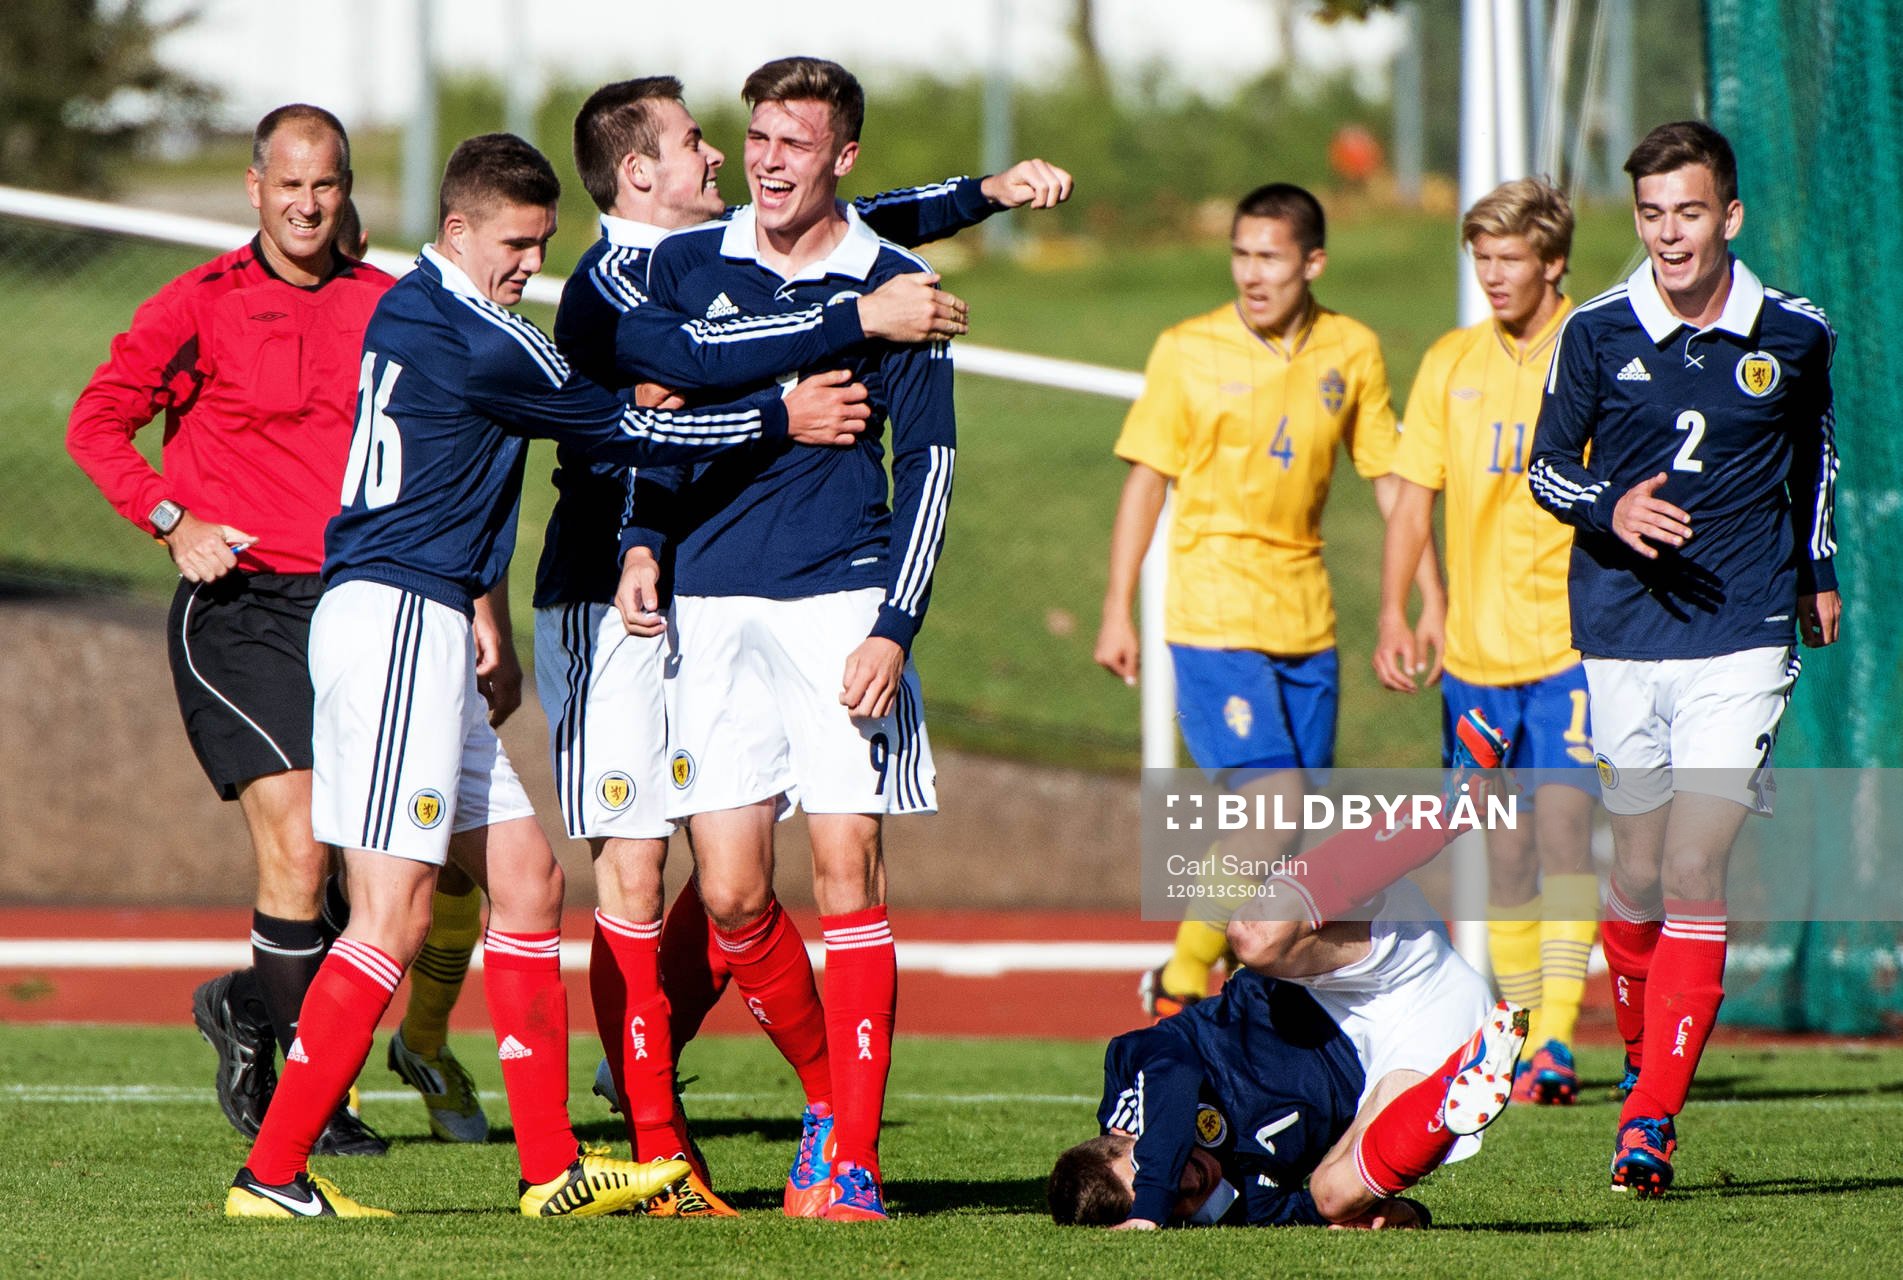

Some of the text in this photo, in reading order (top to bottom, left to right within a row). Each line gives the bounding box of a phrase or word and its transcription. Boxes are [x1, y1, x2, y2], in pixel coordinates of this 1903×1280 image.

[1617, 371, 1651, 381] adidas
[340, 351, 403, 510] 16
[1269, 415, 1295, 470] 4
[1487, 422, 1525, 474] 11
[1673, 410, 1706, 472] 2
[870, 732, 889, 795] 9
[1747, 733, 1771, 793] 2
[631, 1016, 648, 1060] ALBA
[857, 1018, 873, 1061] ALBA
[1672, 1016, 1693, 1057] ALBA
